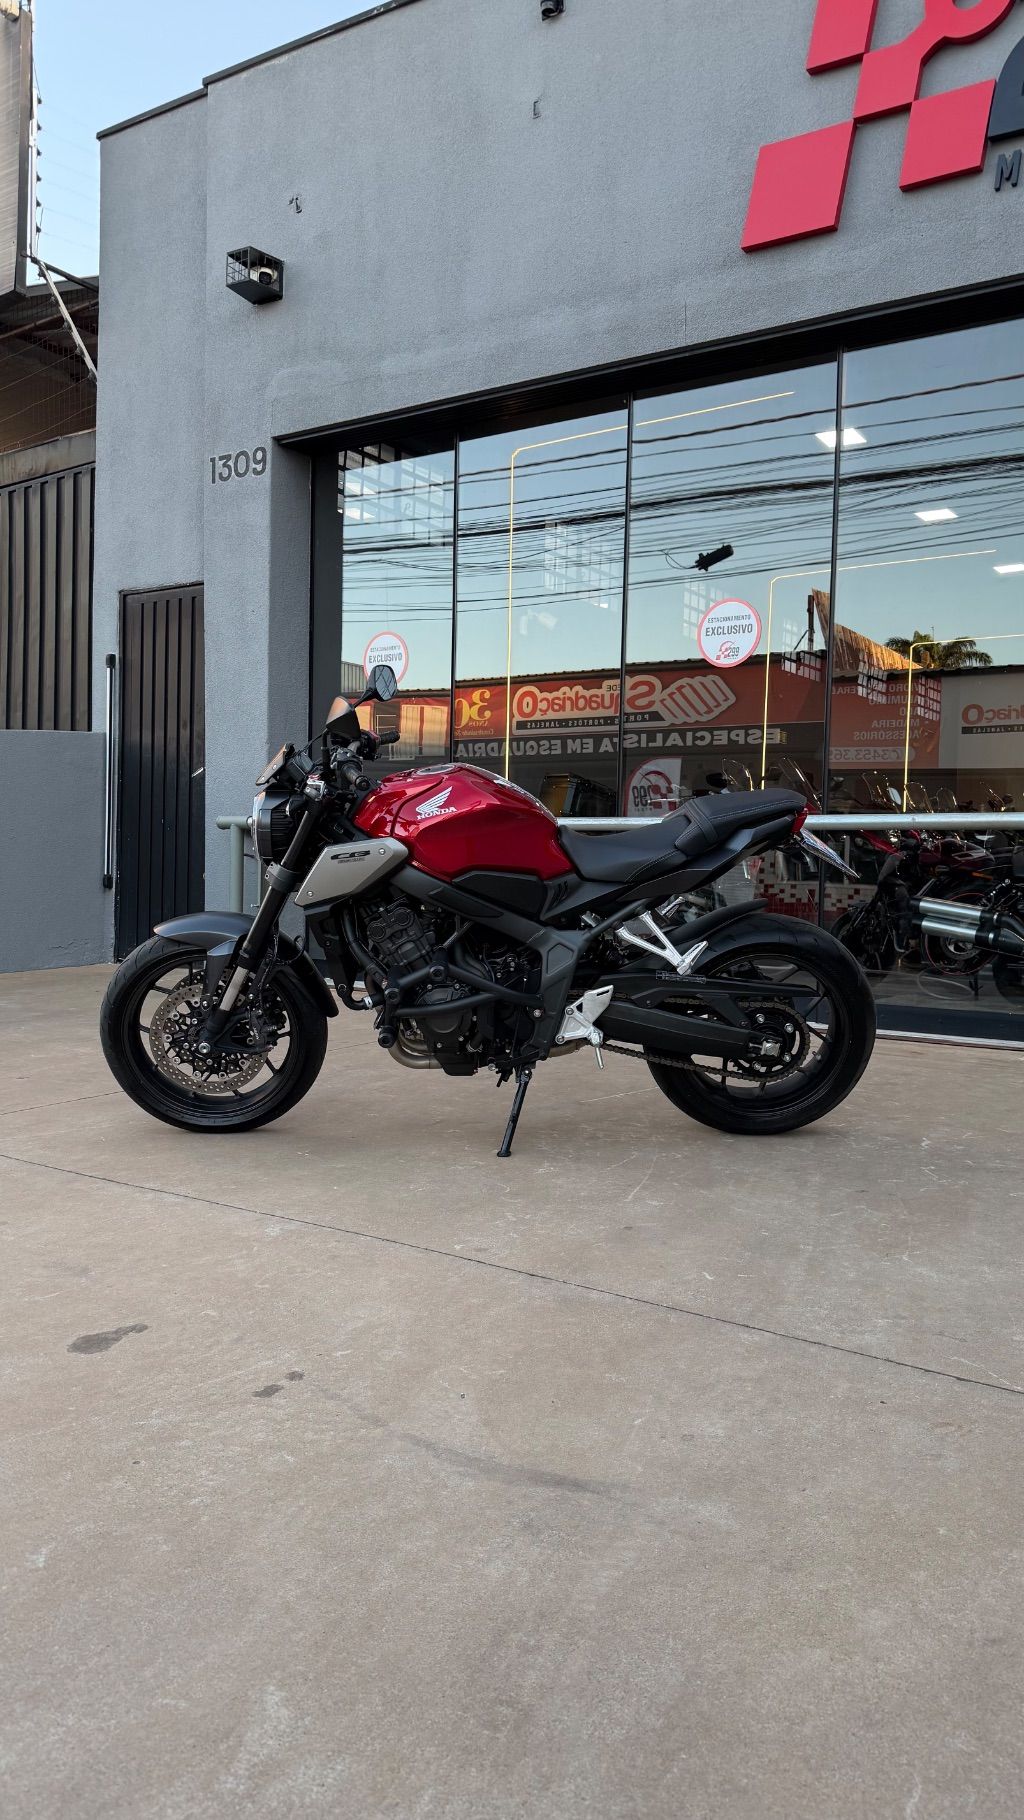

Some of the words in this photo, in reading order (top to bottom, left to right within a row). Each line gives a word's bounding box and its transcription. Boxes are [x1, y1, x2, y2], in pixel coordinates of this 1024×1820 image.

[209, 446, 267, 484] 1309
[705, 623, 753, 637] EXCLUSIVO
[368, 652, 403, 664] EXCLUSIVO
[416, 806, 458, 820] HONDA
